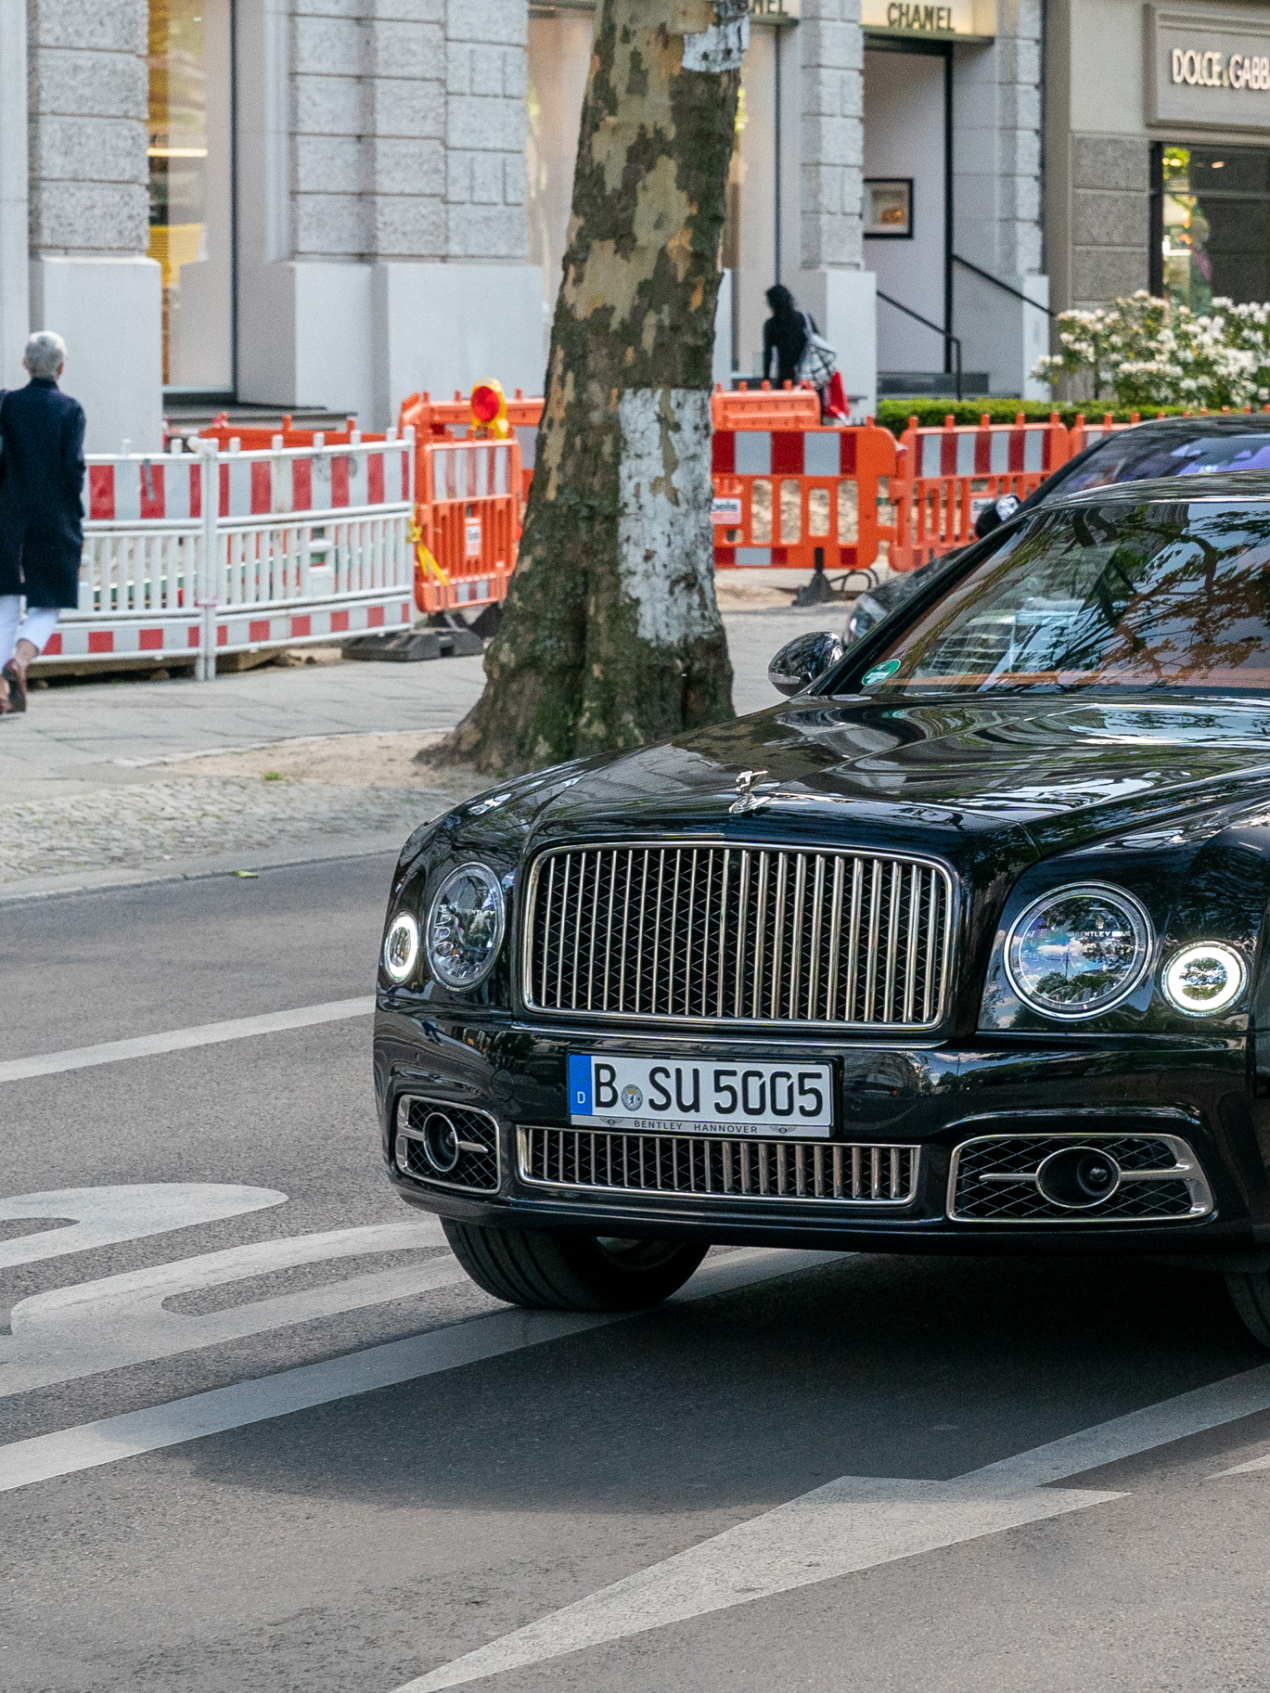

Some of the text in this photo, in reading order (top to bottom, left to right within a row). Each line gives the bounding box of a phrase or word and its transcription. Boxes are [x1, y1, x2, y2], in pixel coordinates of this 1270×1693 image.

[887, 3, 955, 31] CHANEL
[577, 1091, 586, 1104] D
[594, 1063, 823, 1117] B SU 5005
[633, 1119, 758, 1134] BENTLEY HANNOVER
